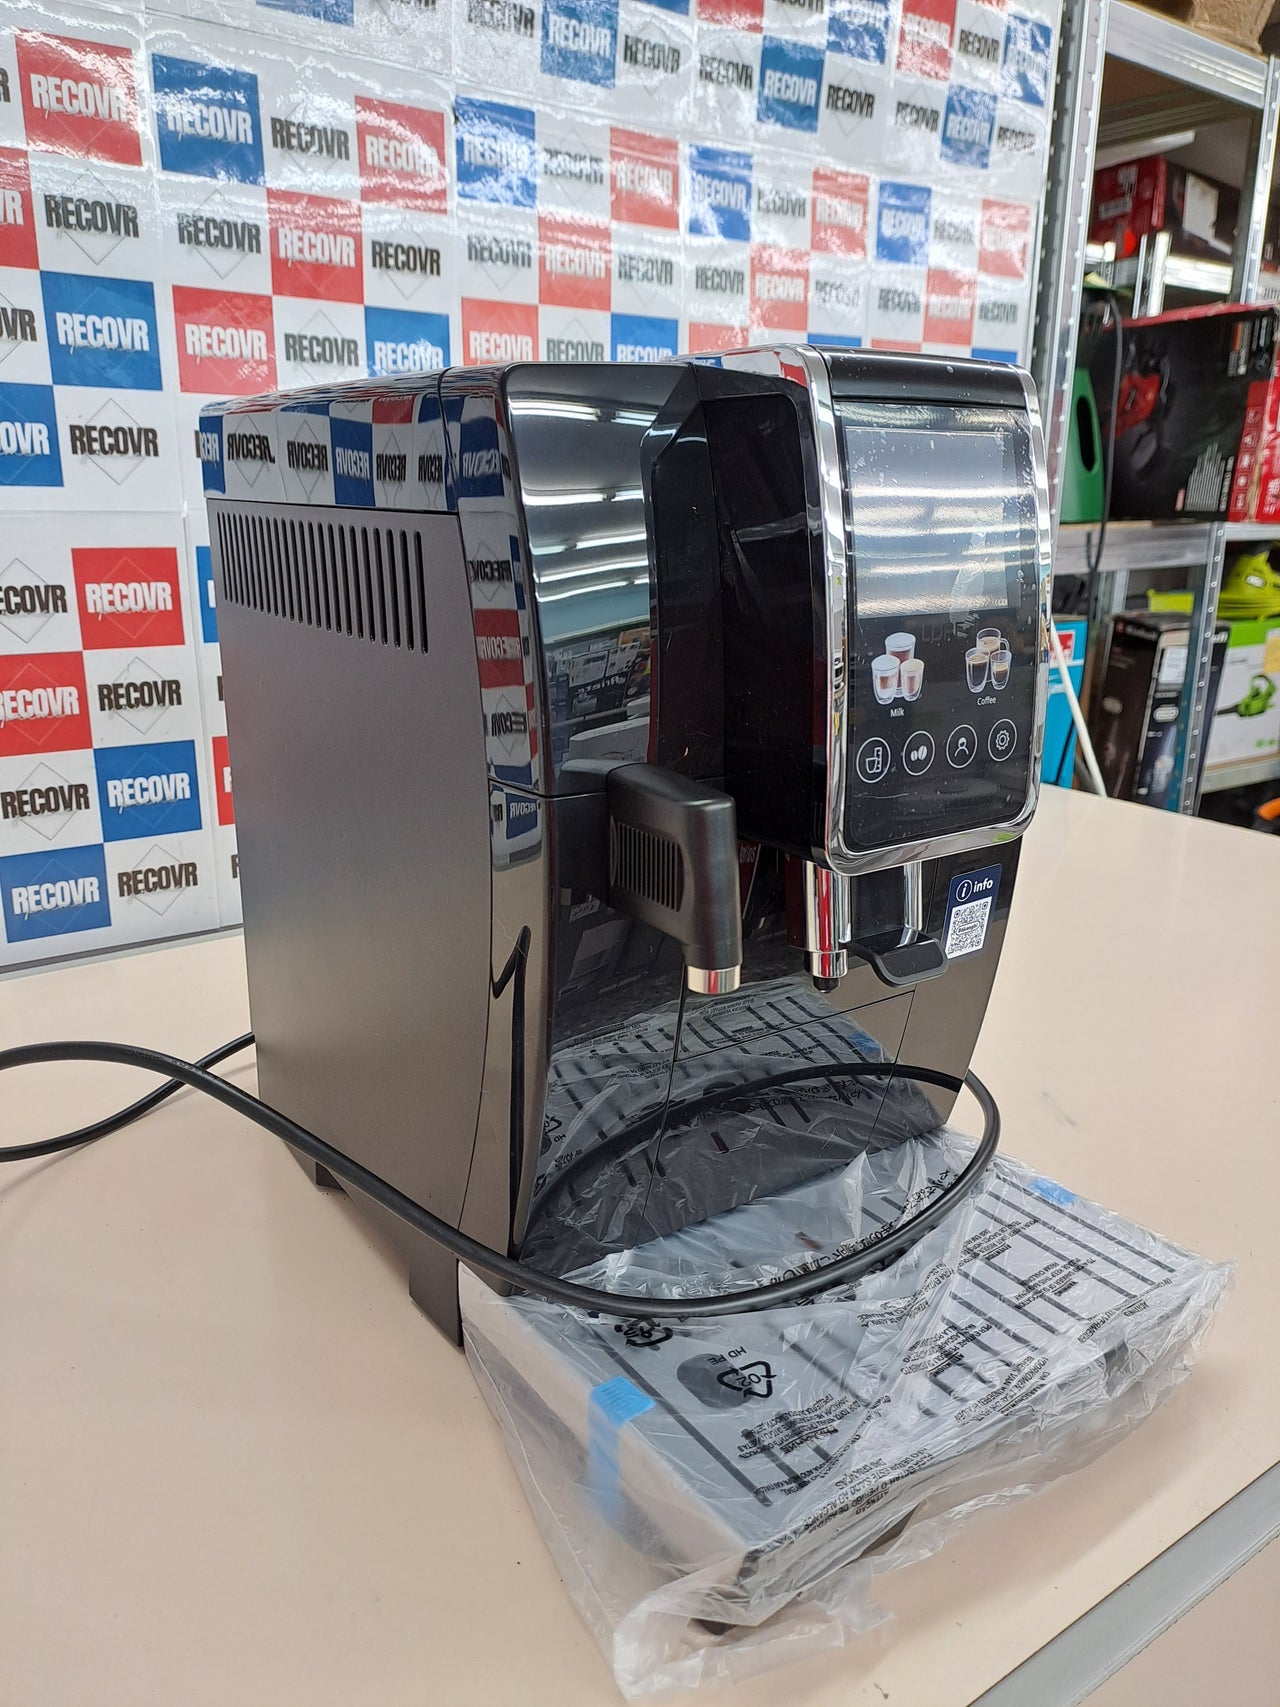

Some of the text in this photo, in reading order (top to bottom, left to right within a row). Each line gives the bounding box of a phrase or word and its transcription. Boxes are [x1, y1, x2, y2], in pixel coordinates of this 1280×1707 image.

[30, 74, 128, 122] RECOVR
[764, 68, 817, 107] RECOVR
[826, 84, 875, 119] RECOVR
[270, 116, 350, 161] RECOVR
[43, 194, 140, 238] RECOVR
[179, 212, 262, 254] RECOVR
[278, 227, 356, 268] RECOVR
[372, 240, 441, 276] RECOVR
[696, 266, 744, 295] RECOVR
[56, 312, 150, 352] RECOVR
[184, 324, 268, 362] RECOVR
[470, 331, 533, 362] RECOVR
[284, 333, 359, 367] RECOVR
[374, 341, 444, 372] RECOVR
[546, 338, 605, 362] RECOVR
[69, 424, 159, 457] RECOVR
[84, 581, 174, 614] RECOVR
[98, 680, 182, 712] RECOVR
[890, 708, 904, 717] Milk
[977, 696, 996, 706] Coffee
[0, 783, 90, 819] RECOVR
[106, 772, 191, 808] RECOVR
[11, 876, 100, 914] RECOVR
[117, 862, 198, 897] RECOVR
[973, 877, 994, 893] info
[708, 1346, 747, 1366] HD PE
[736, 1373, 761, 1388] 02
